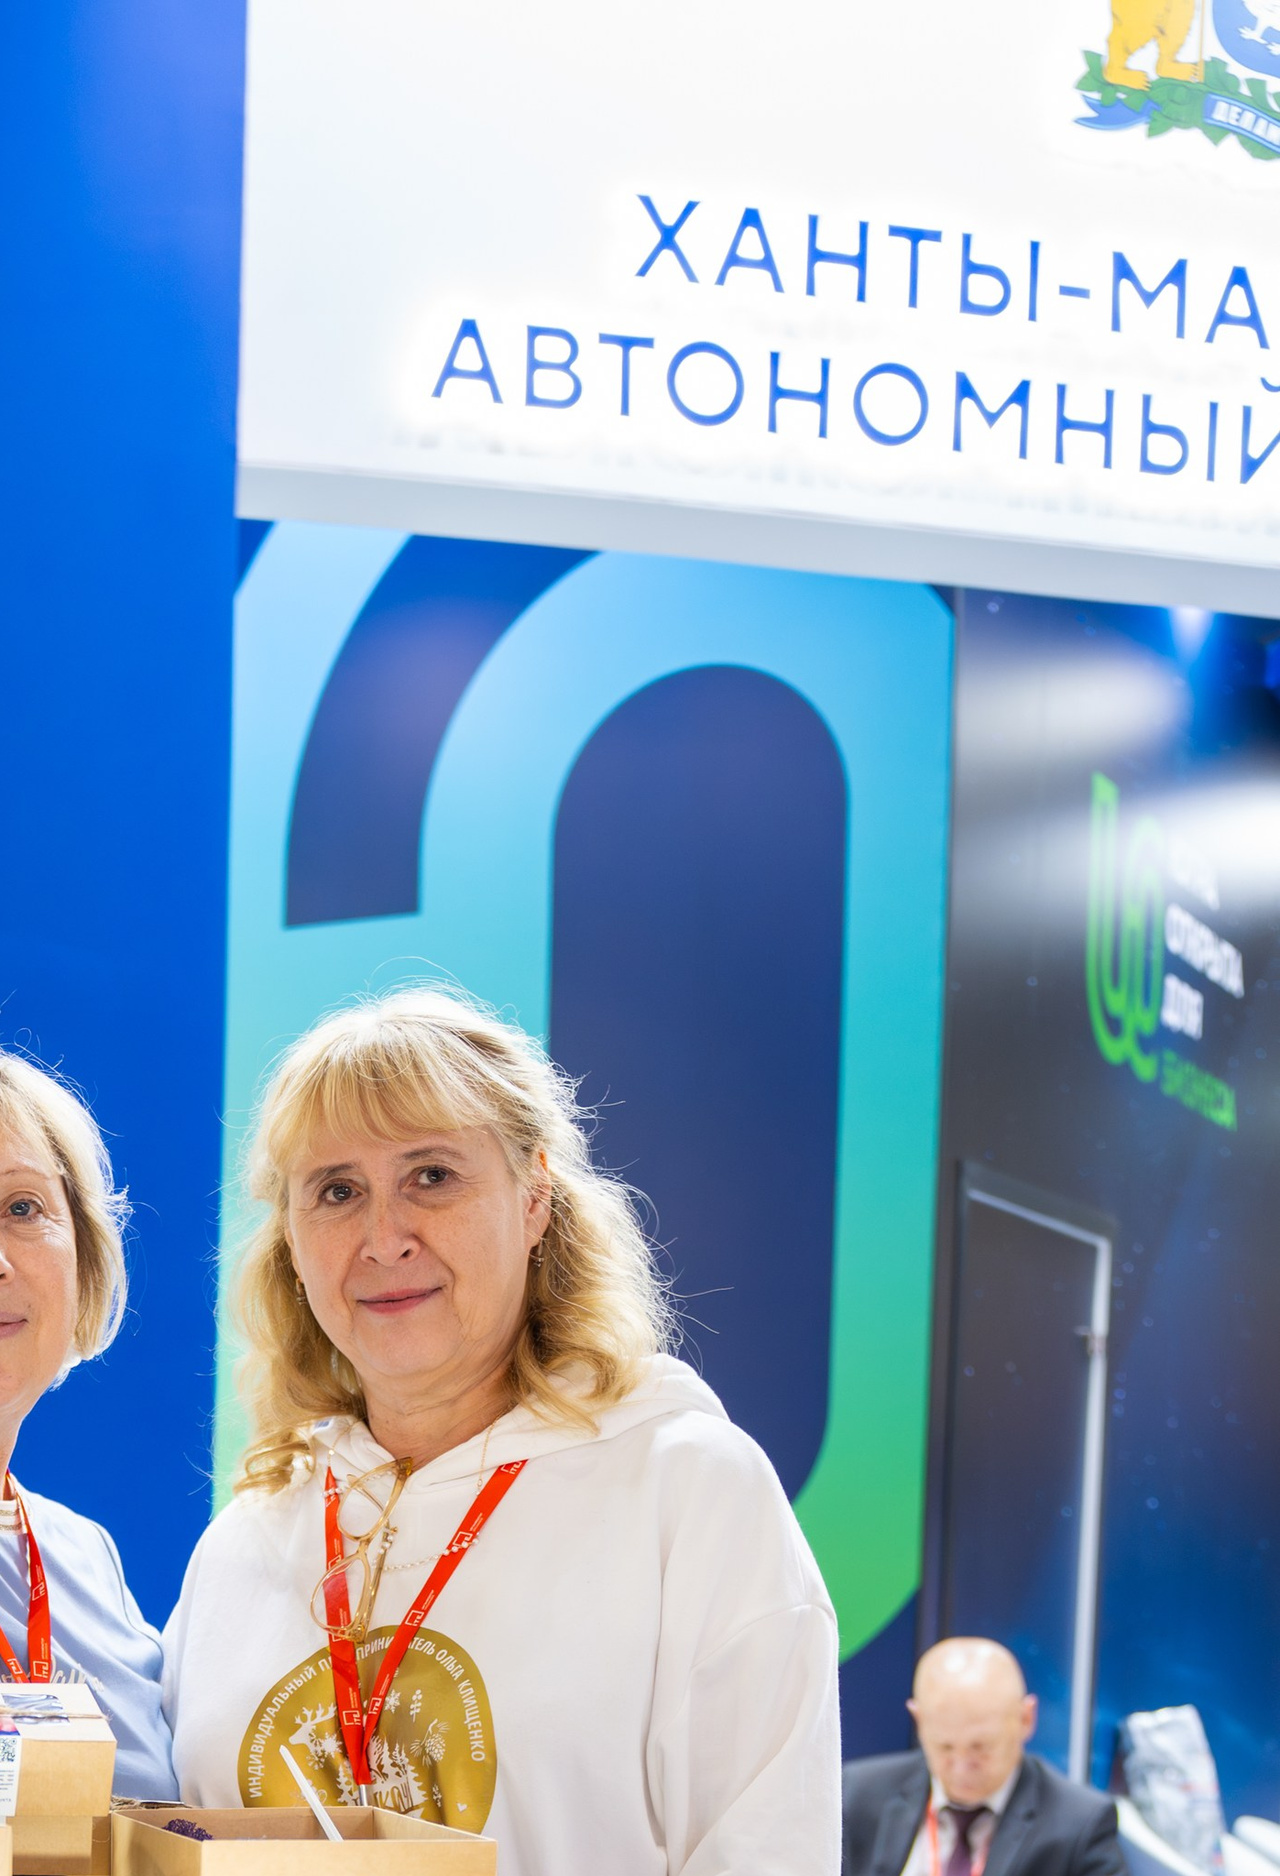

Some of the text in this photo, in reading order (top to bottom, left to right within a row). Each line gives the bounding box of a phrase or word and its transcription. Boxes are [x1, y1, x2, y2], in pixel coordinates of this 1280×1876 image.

[248, 1663, 318, 1799] ИНДИВИДУАЛЬНЫЙ
[435, 1649, 465, 1681] ОЛЬГА
[457, 1678, 487, 1763] КЛИЩЕНКО
